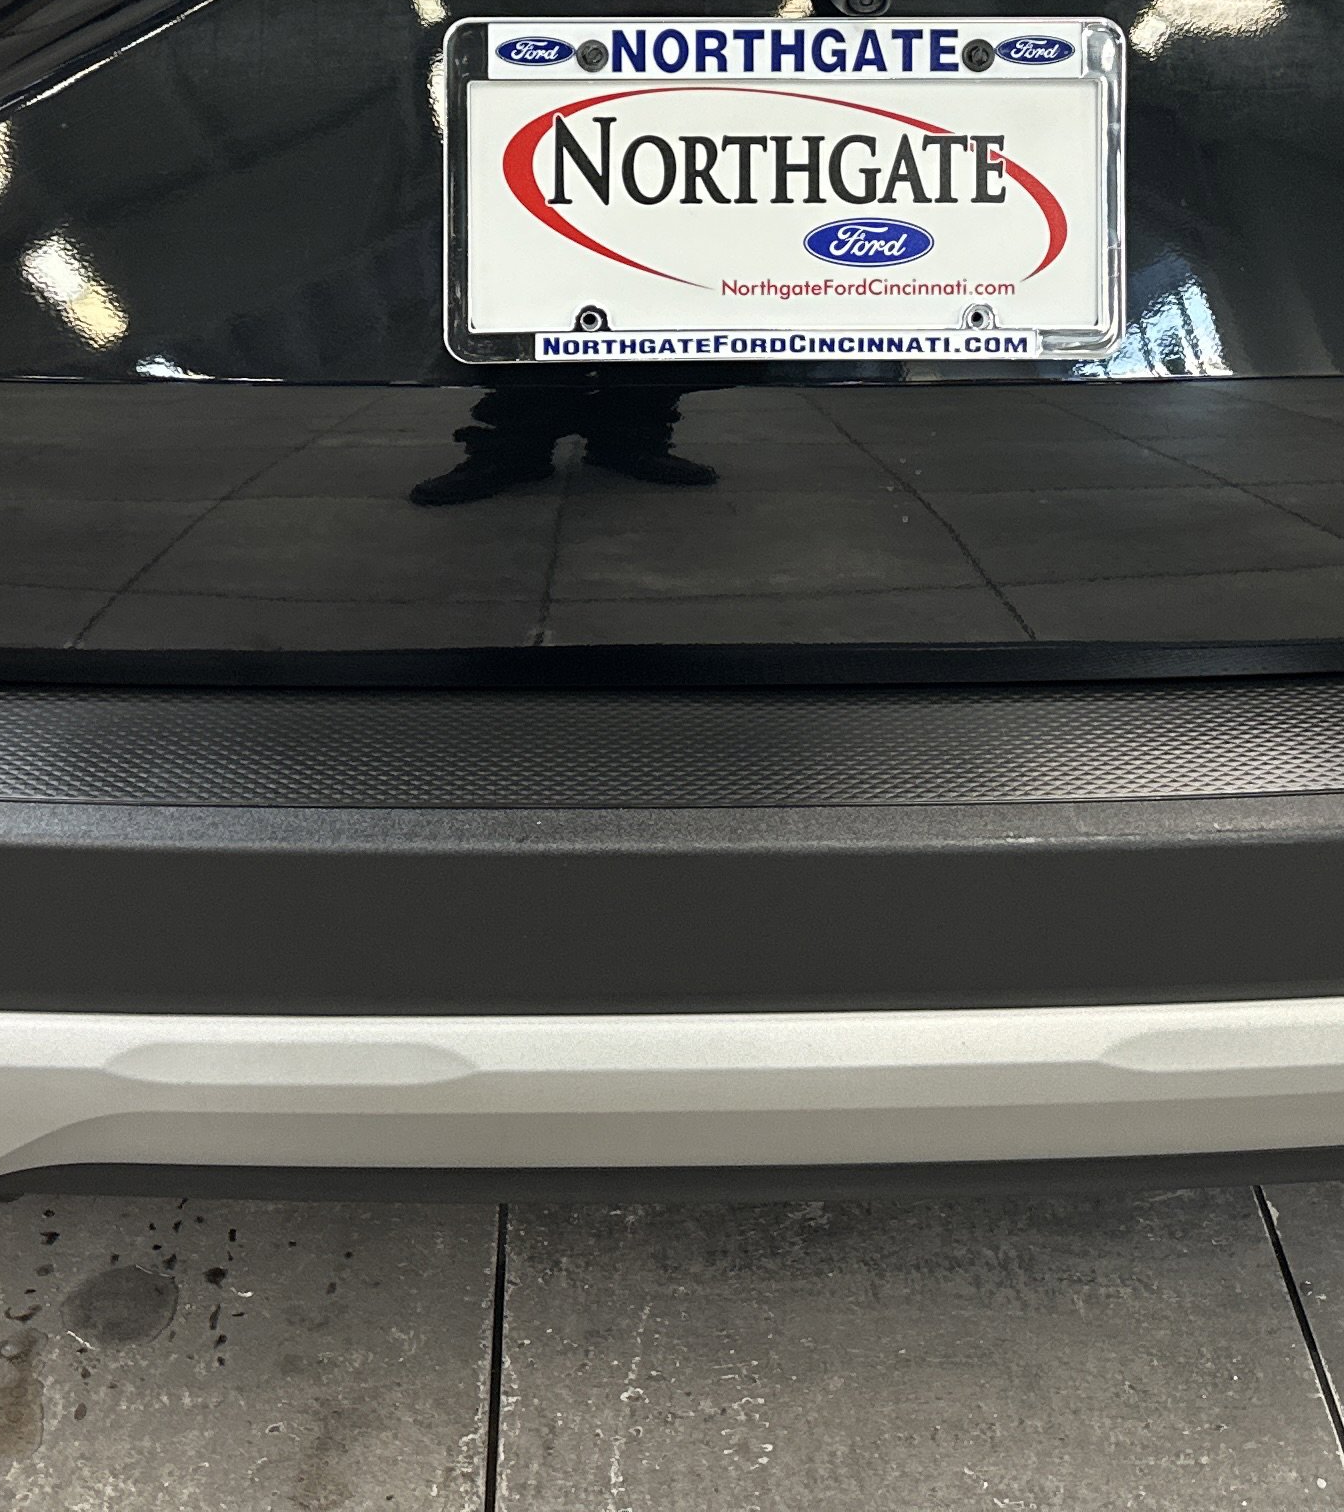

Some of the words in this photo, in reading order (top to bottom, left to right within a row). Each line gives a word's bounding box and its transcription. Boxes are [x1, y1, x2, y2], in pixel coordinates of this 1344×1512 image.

[510, 41, 558, 61] Ford
[611, 28, 959, 73] NORTHGATE
[1009, 40, 1059, 60] Ford
[829, 225, 907, 257] Ford
[721, 279, 1016, 300] NorthgateFordCincinnati.com
